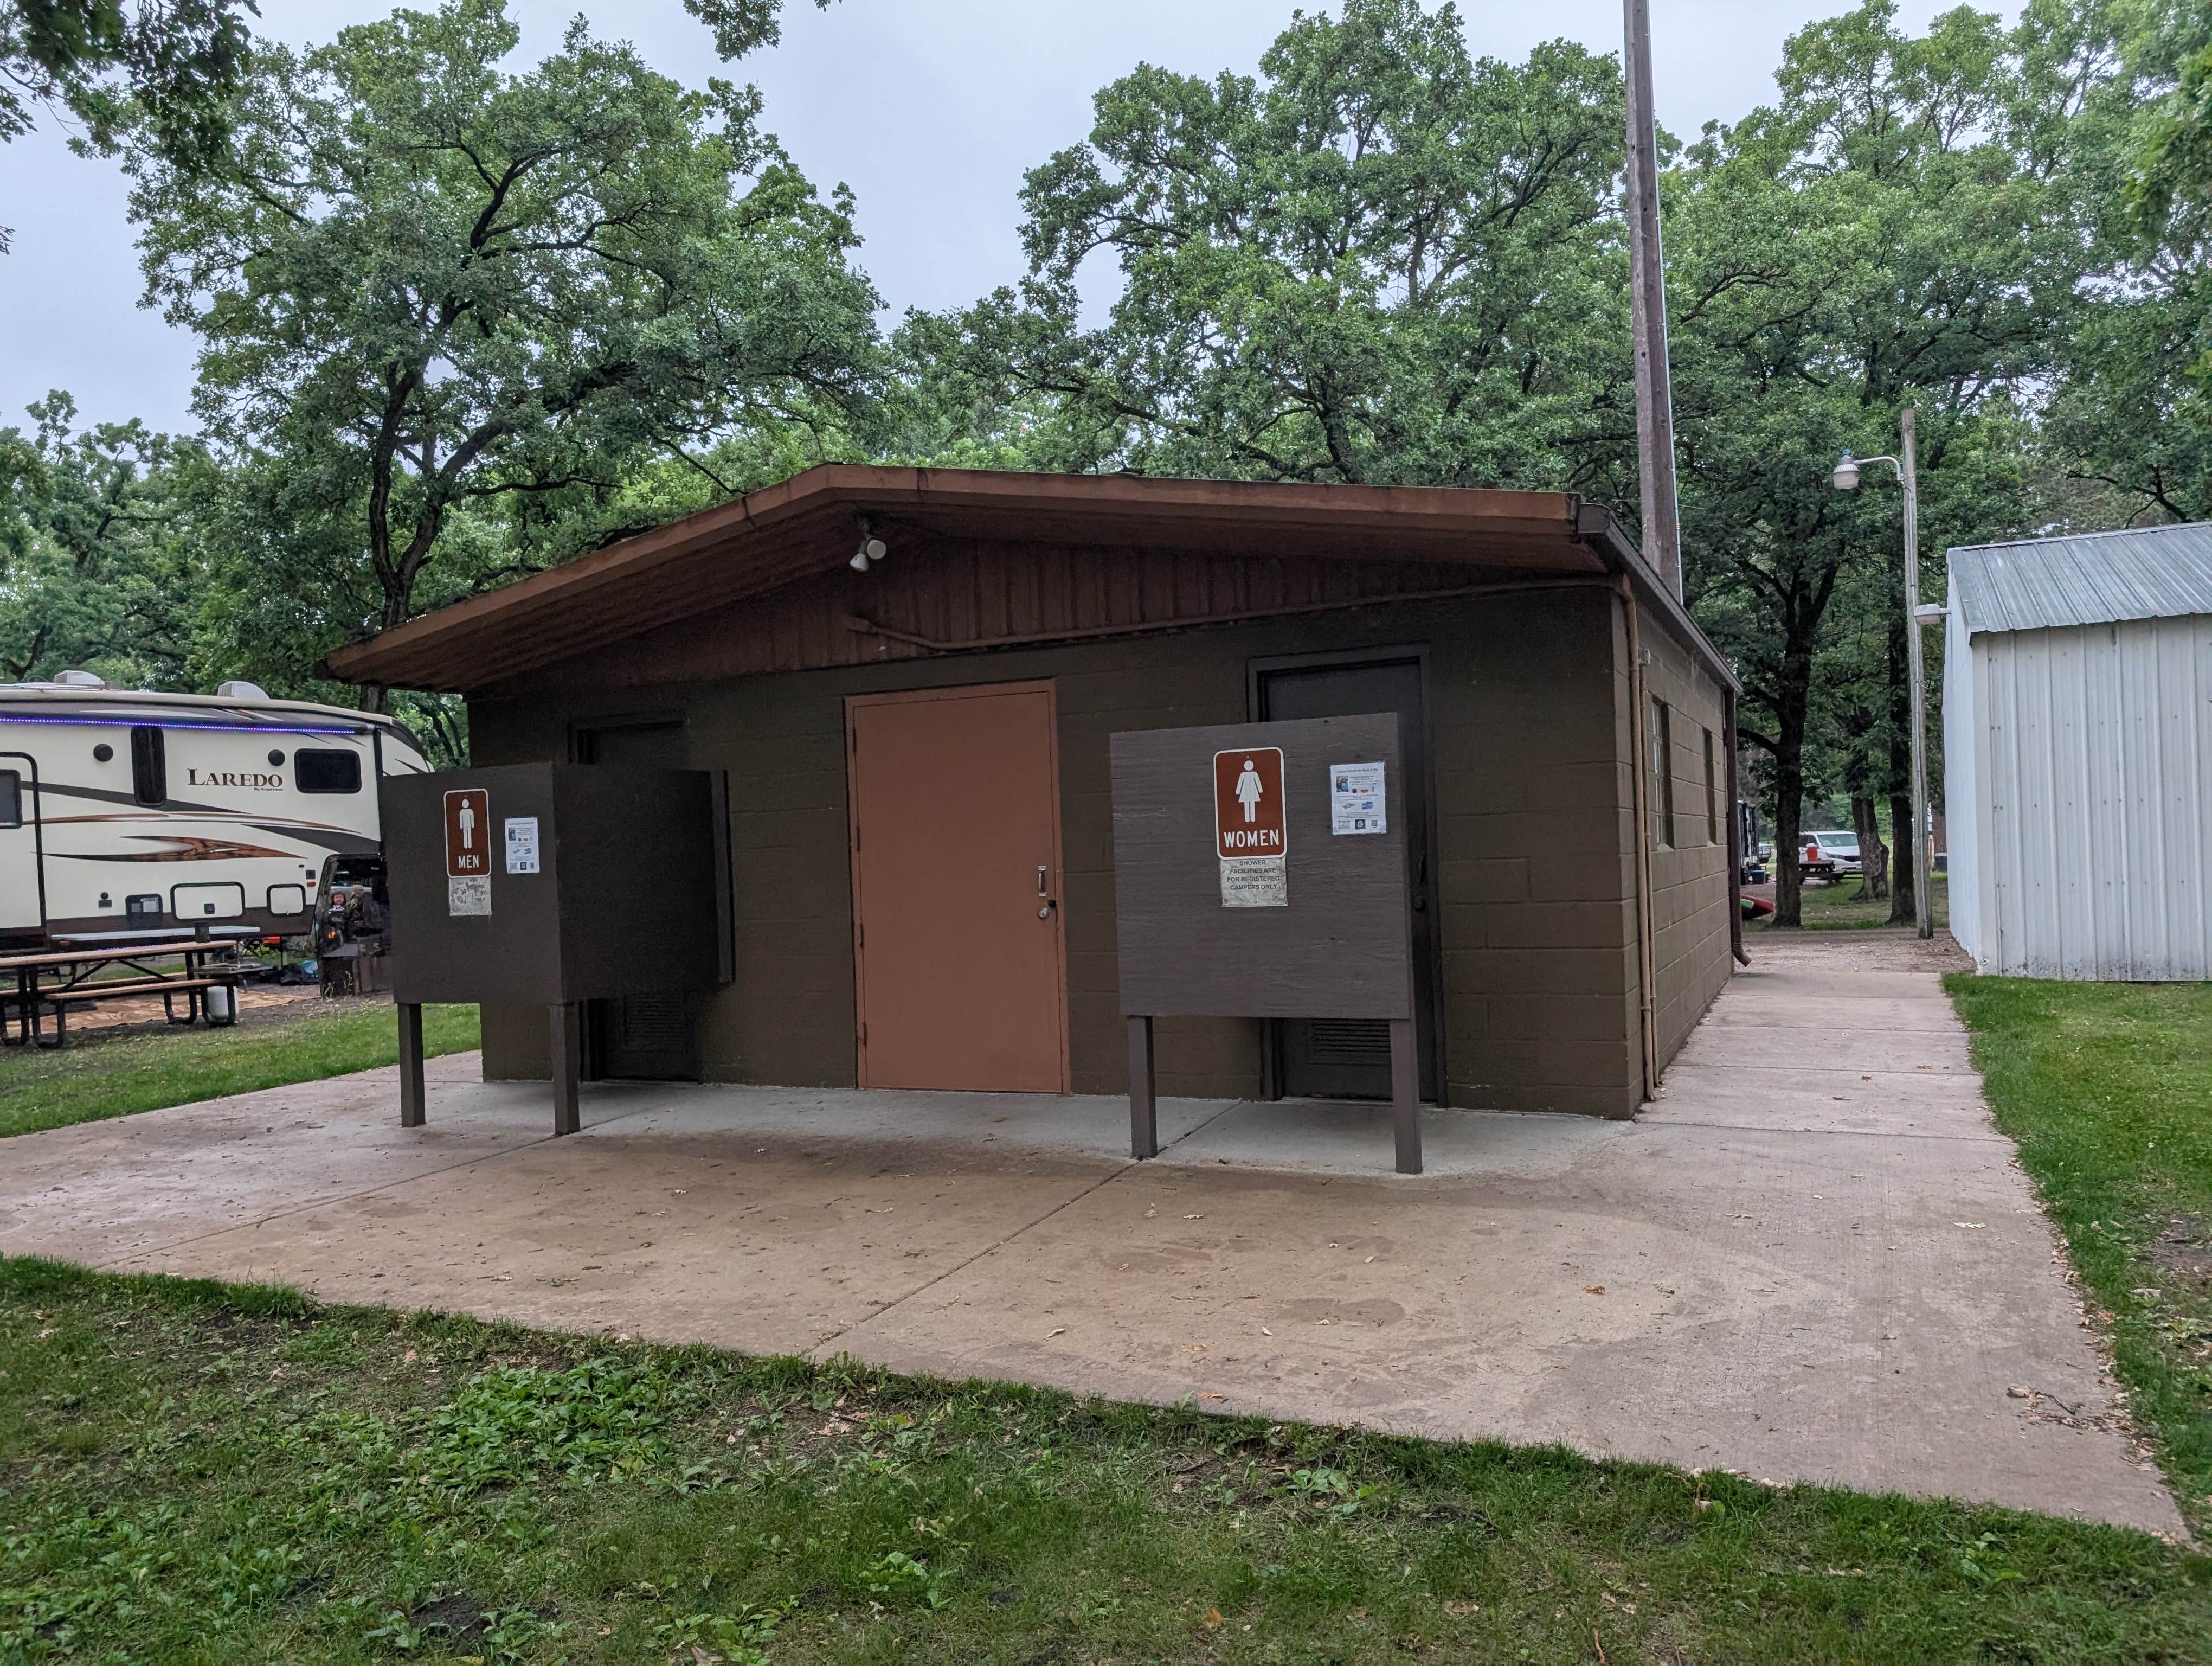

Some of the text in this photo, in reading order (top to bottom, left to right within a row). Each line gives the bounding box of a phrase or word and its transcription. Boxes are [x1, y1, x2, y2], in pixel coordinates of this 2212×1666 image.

[187, 768, 283, 787] LAREDO
[1224, 829, 1279, 848] WOMEN
[458, 855, 479, 869] MEN
